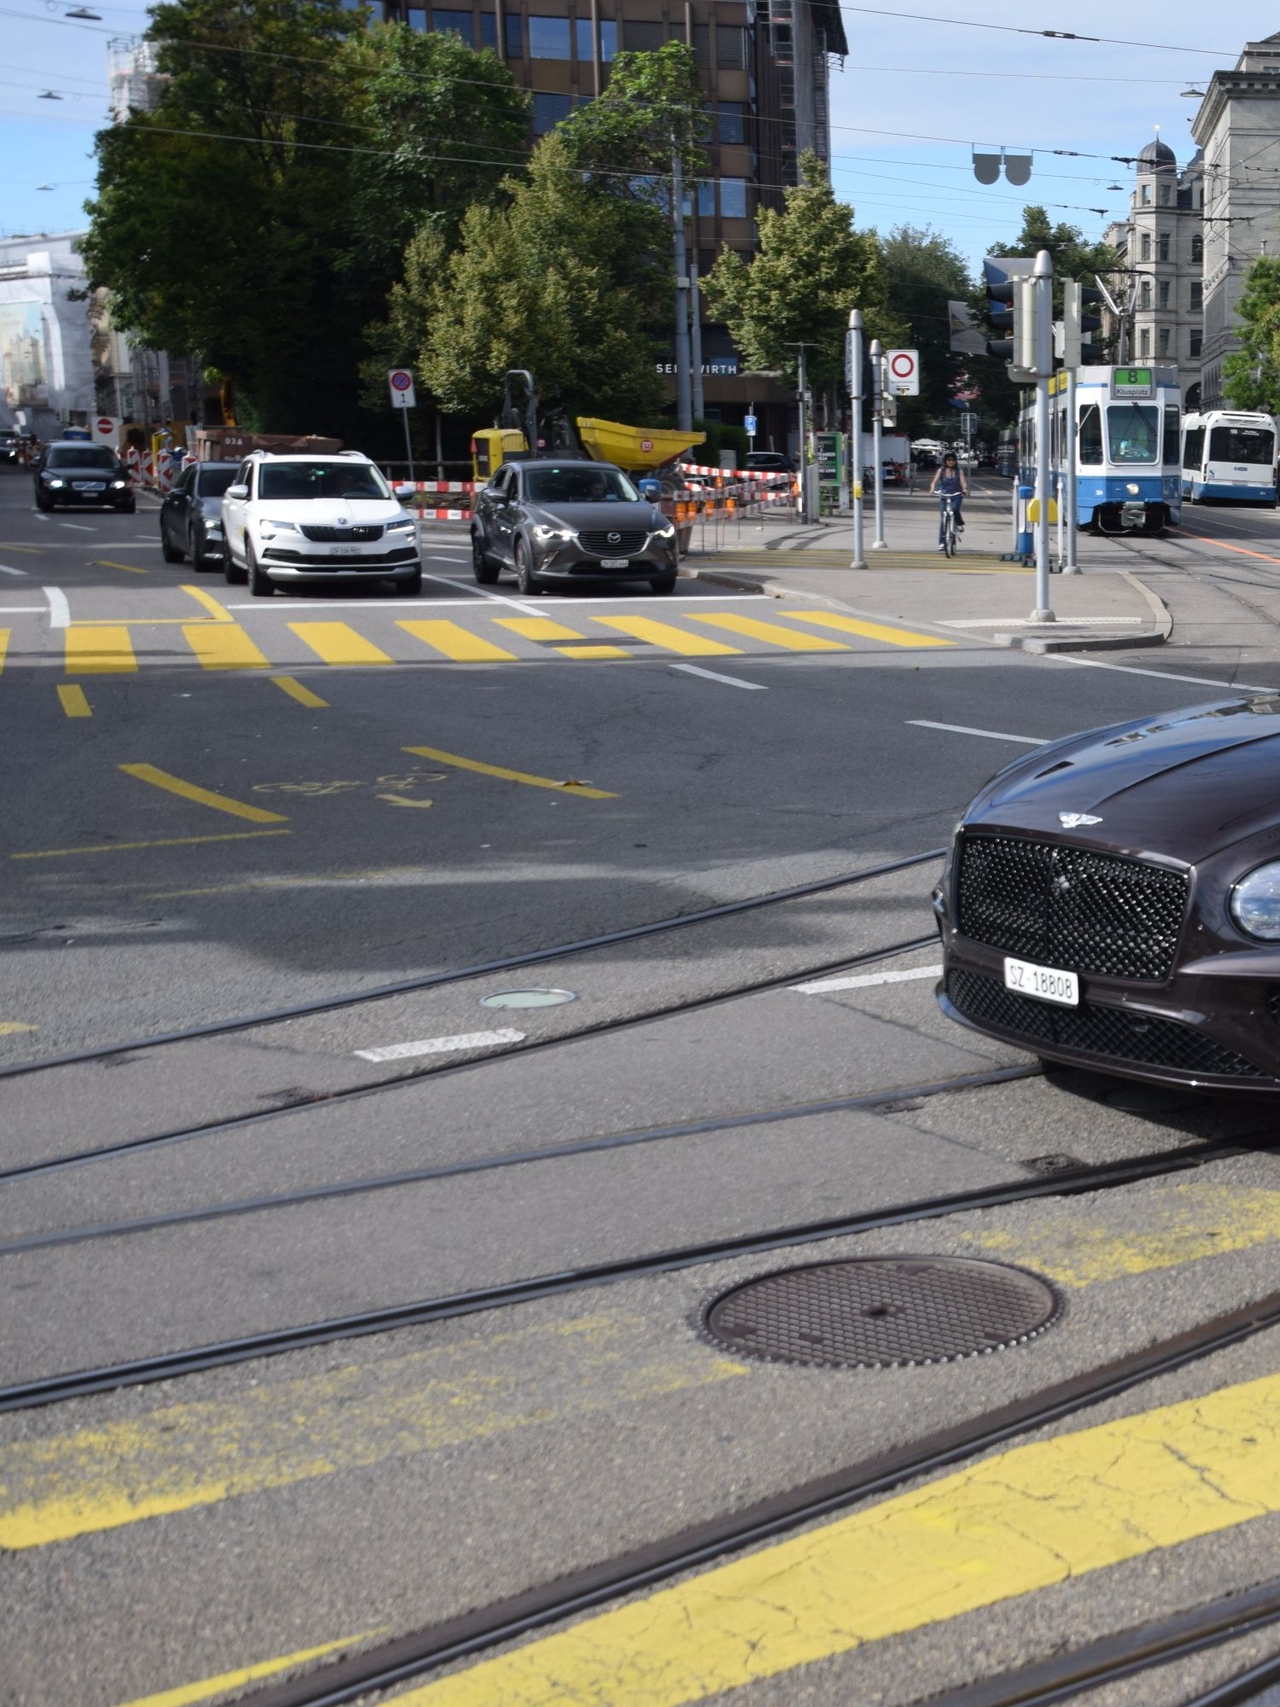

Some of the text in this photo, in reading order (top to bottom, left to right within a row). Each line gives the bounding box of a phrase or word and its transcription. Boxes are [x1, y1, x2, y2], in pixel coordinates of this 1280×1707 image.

[1128, 370, 1138, 384] 8
[1116, 388, 1149, 396] Klusplatz
[1010, 965, 1073, 999] SZ 18808
